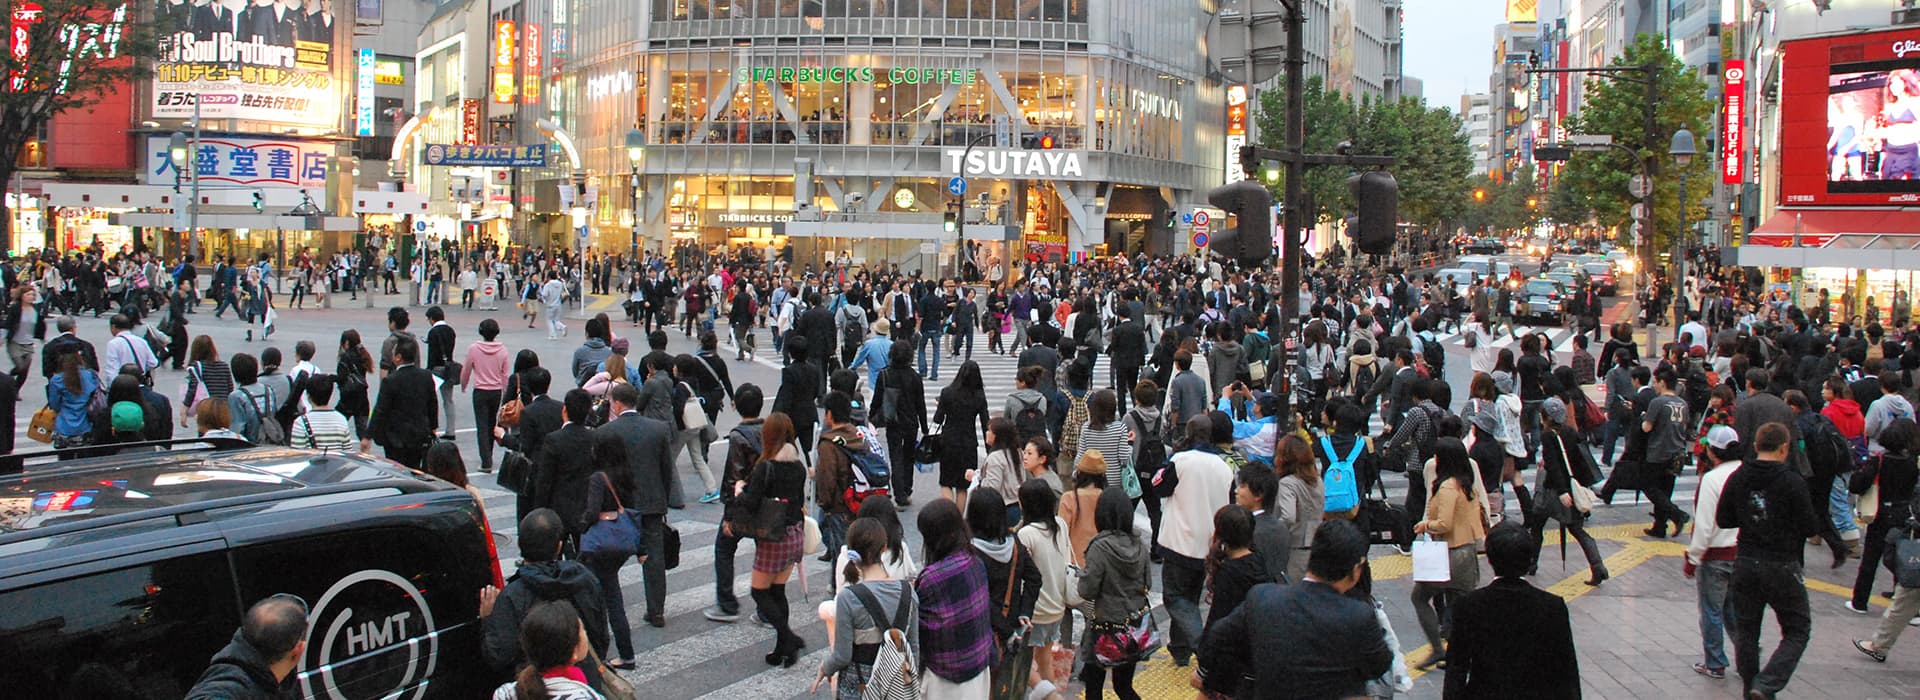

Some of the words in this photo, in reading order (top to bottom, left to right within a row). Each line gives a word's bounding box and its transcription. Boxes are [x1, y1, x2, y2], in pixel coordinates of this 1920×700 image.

[182, 32, 218, 62] Soul
[219, 31, 295, 68] Brothers
[737, 66, 874, 84] STARBUCKS
[889, 66, 977, 85] COFFEE
[947, 150, 1083, 177] TSUTAYA
[718, 214, 772, 223] STARBUCKS
[346, 611, 411, 656] HMT
